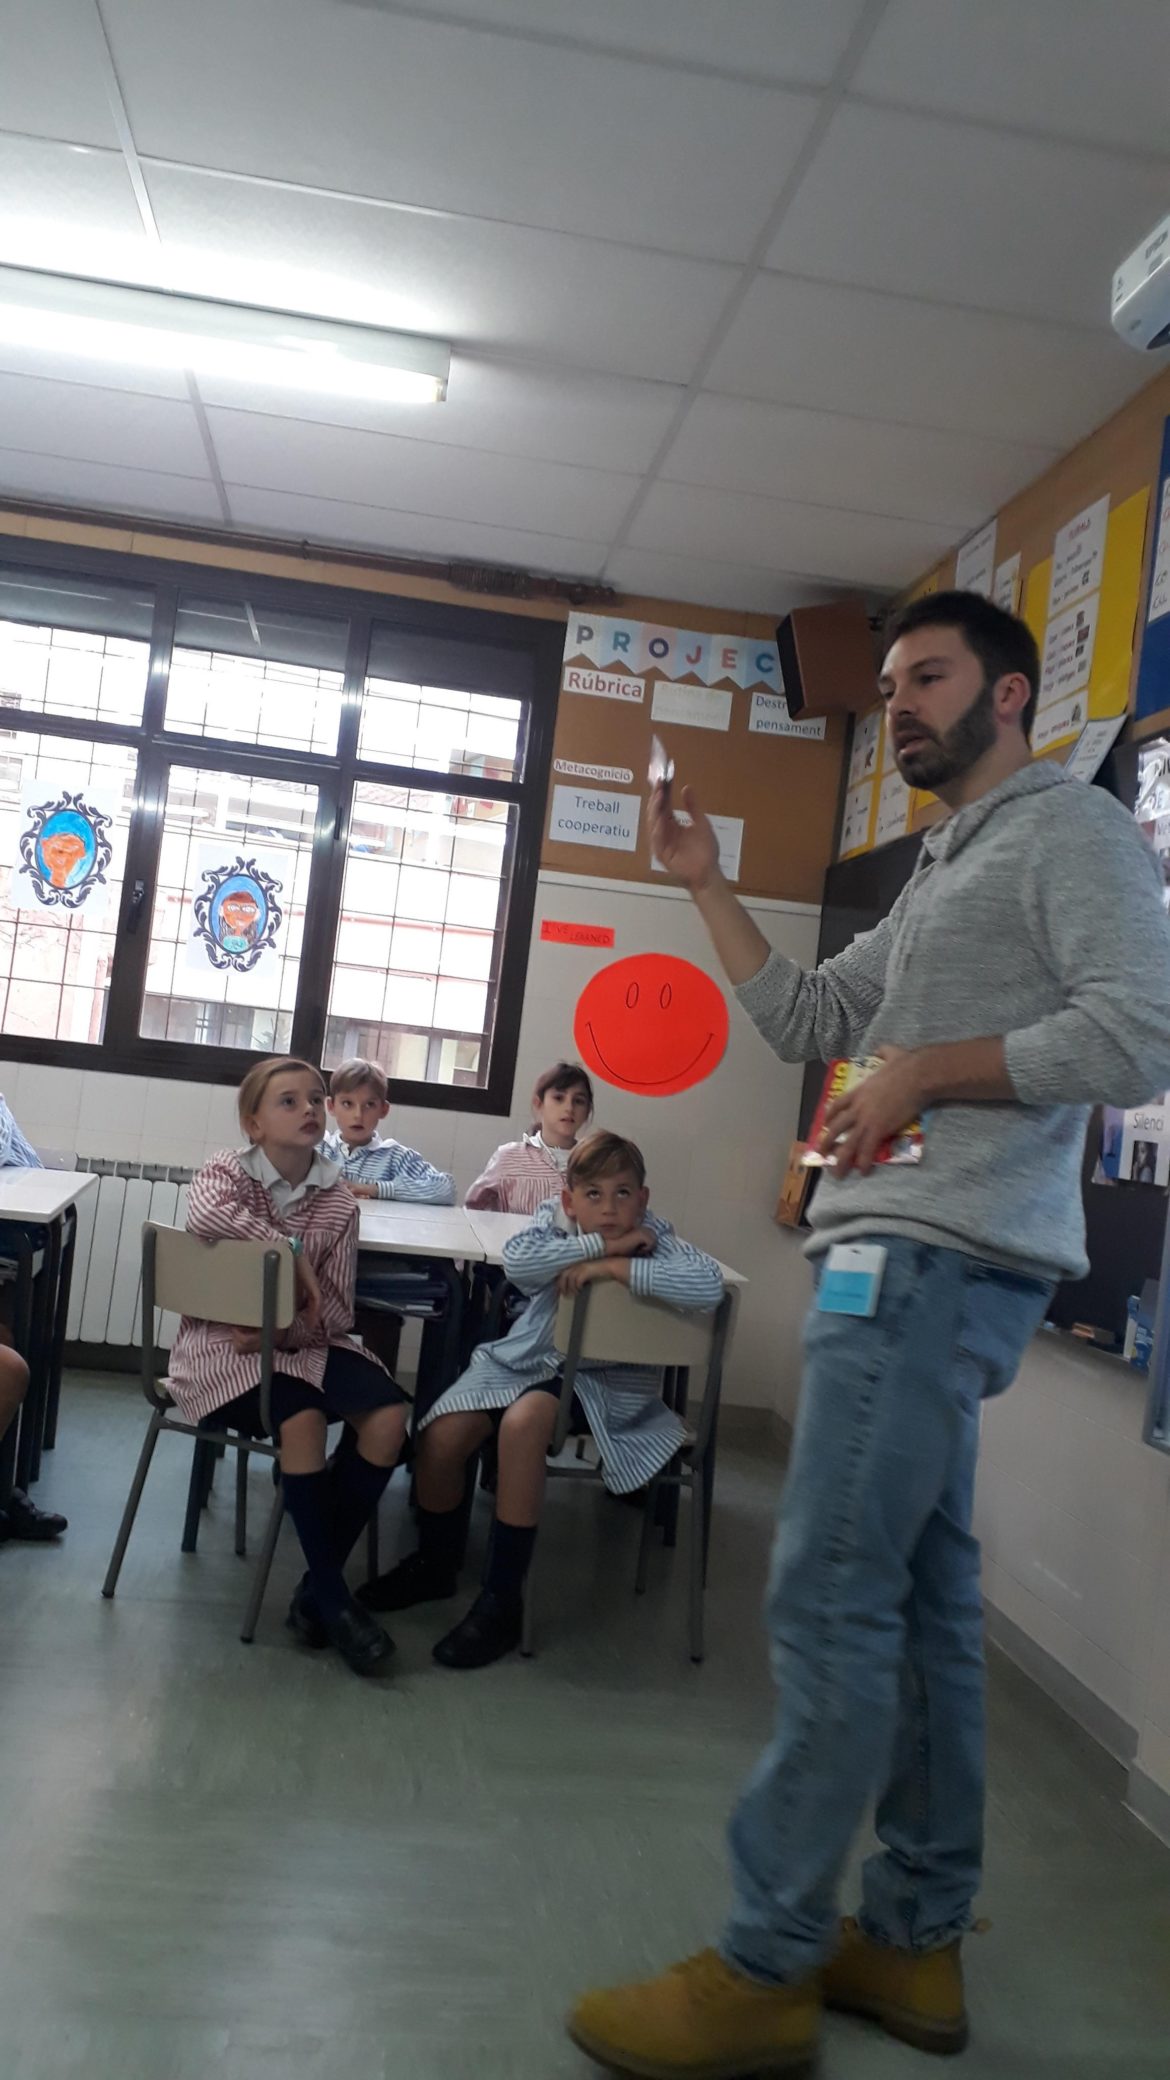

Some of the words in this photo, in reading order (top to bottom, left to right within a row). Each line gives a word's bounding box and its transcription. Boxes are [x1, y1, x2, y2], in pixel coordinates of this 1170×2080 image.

[576, 624, 775, 673] PROJEC
[568, 671, 642, 697] Rúbrica
[756, 695, 787, 709] Destr
[756, 718, 822, 737] pensament
[575, 796, 620, 814] Treball
[558, 818, 631, 838] cooperatiu
[1133, 1112, 1164, 1132] Silenci
